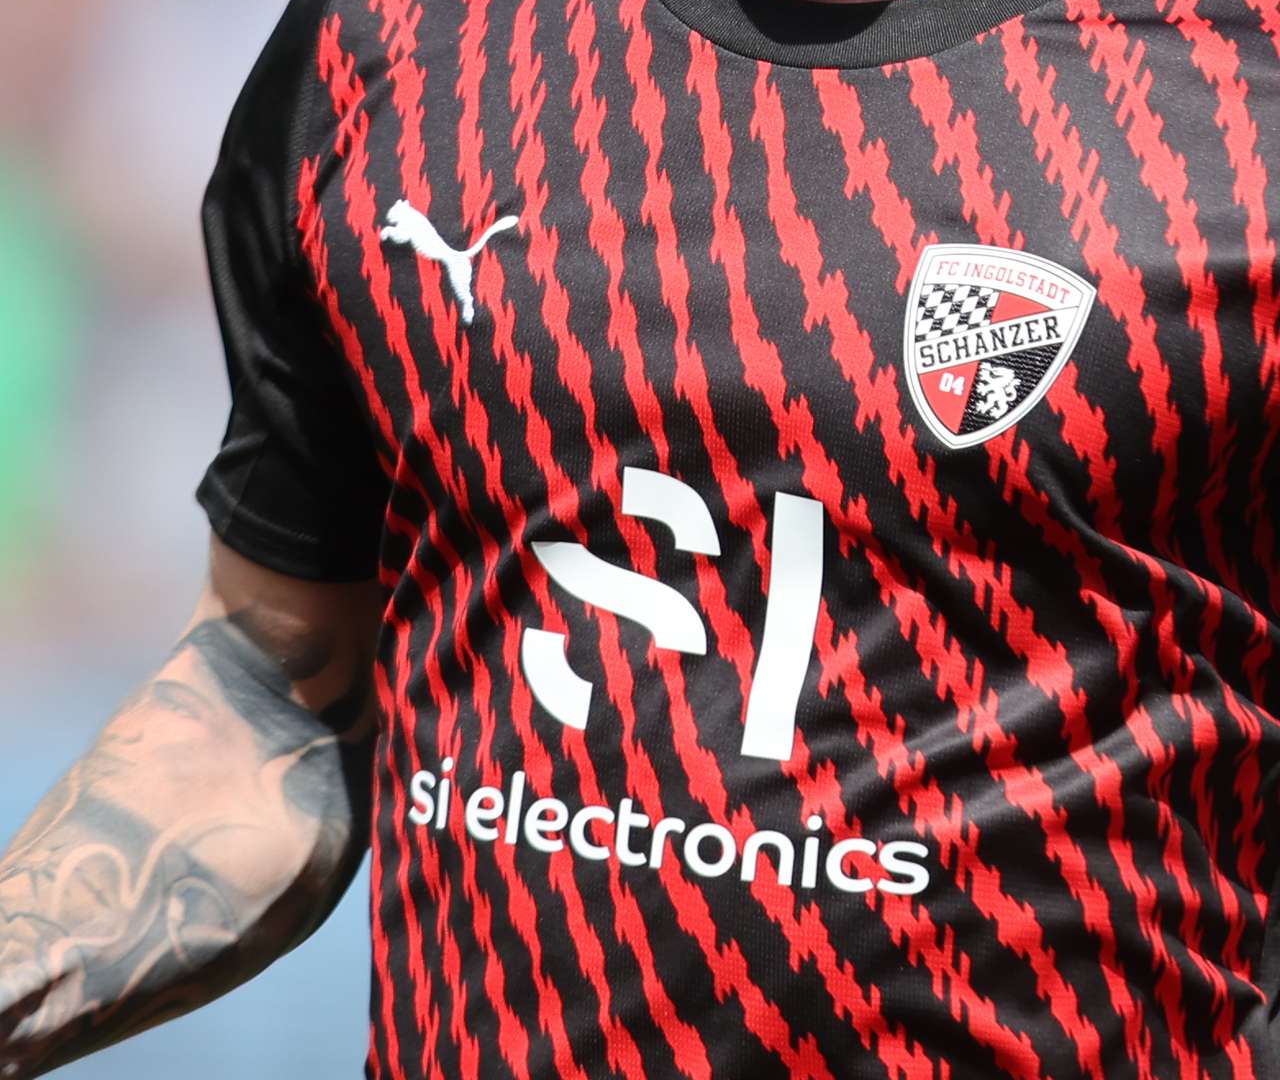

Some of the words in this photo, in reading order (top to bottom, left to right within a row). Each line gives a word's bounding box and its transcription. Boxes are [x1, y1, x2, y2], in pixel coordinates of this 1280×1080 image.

[936, 260, 960, 276] FC
[964, 263, 1070, 304] INGOLSTADT
[920, 315, 1061, 367] SCHANZER
[939, 373, 965, 396] 04
[409, 757, 454, 829] si
[465, 771, 930, 895] electronics
